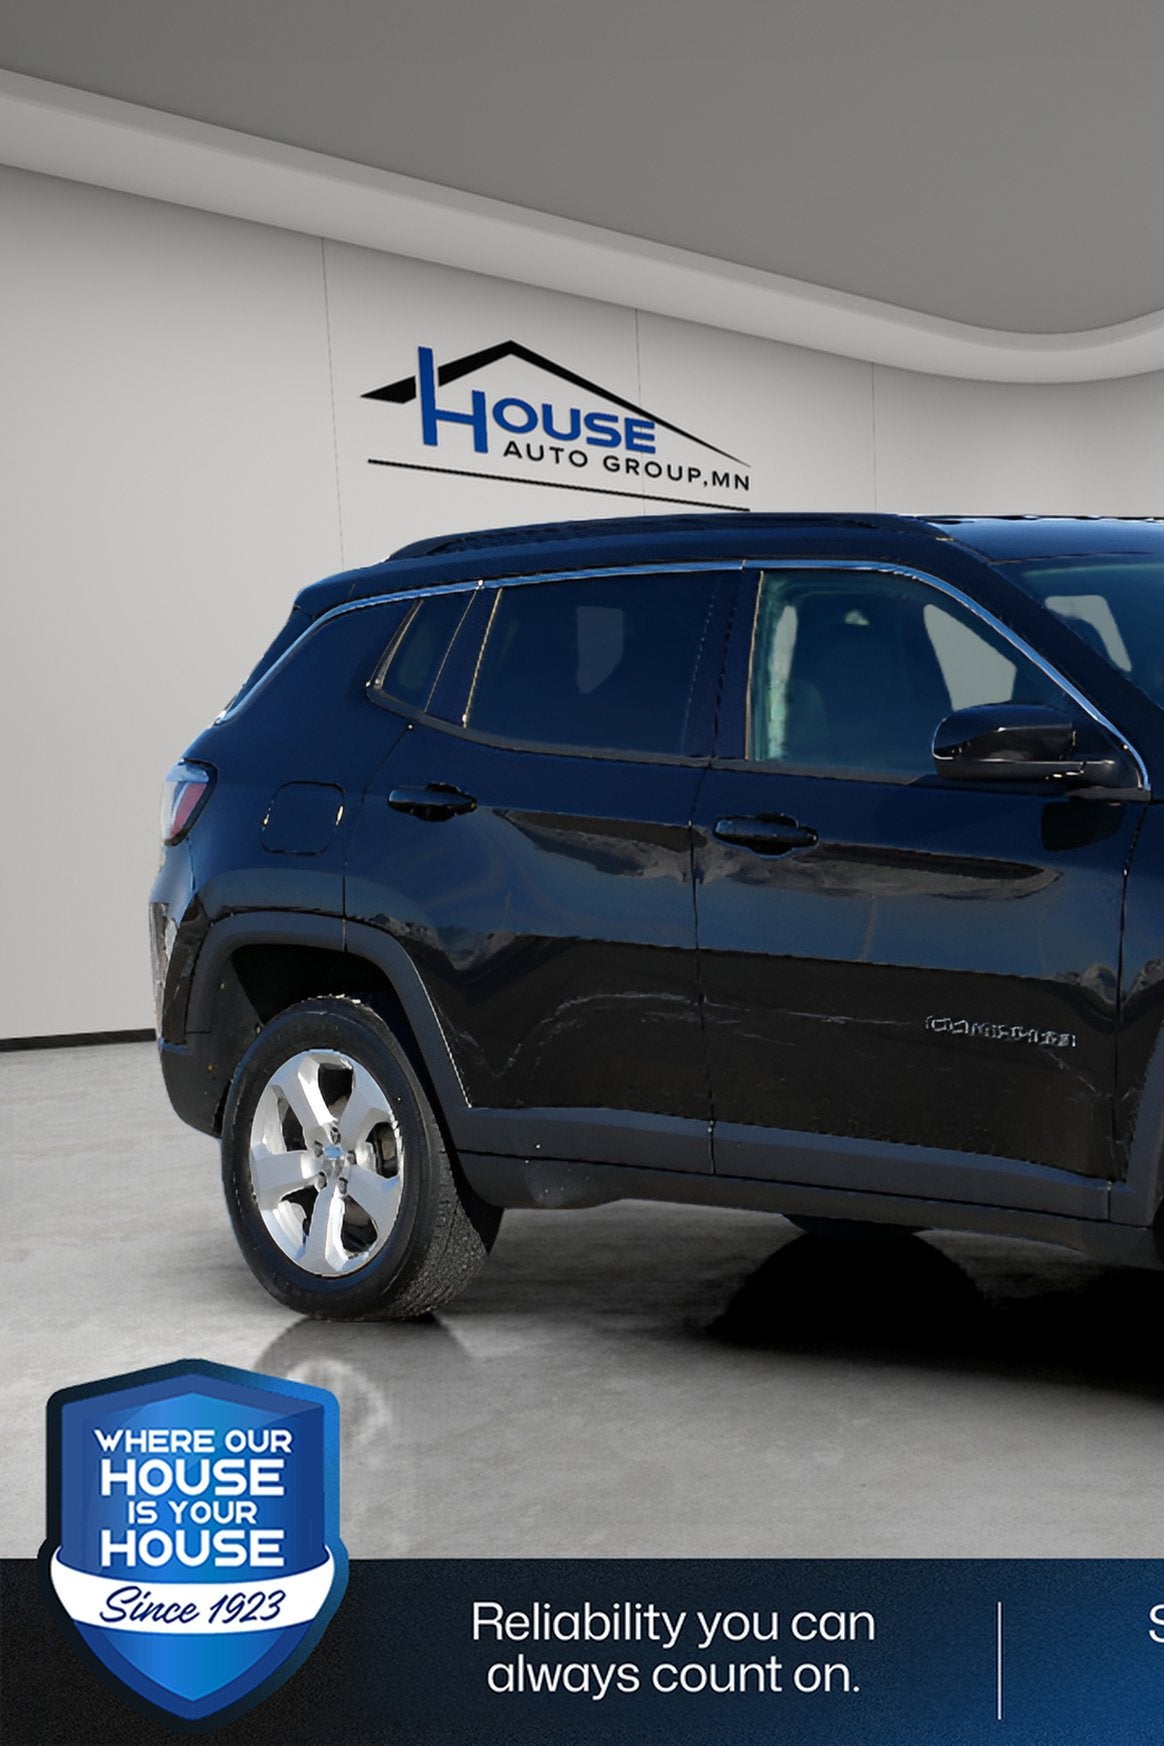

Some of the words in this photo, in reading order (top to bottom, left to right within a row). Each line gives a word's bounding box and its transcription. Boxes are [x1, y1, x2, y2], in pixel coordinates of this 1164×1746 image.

[417, 346, 657, 454] HOUSE
[502, 440, 589, 468] AUTO
[602, 455, 751, 491] GROUP,MN
